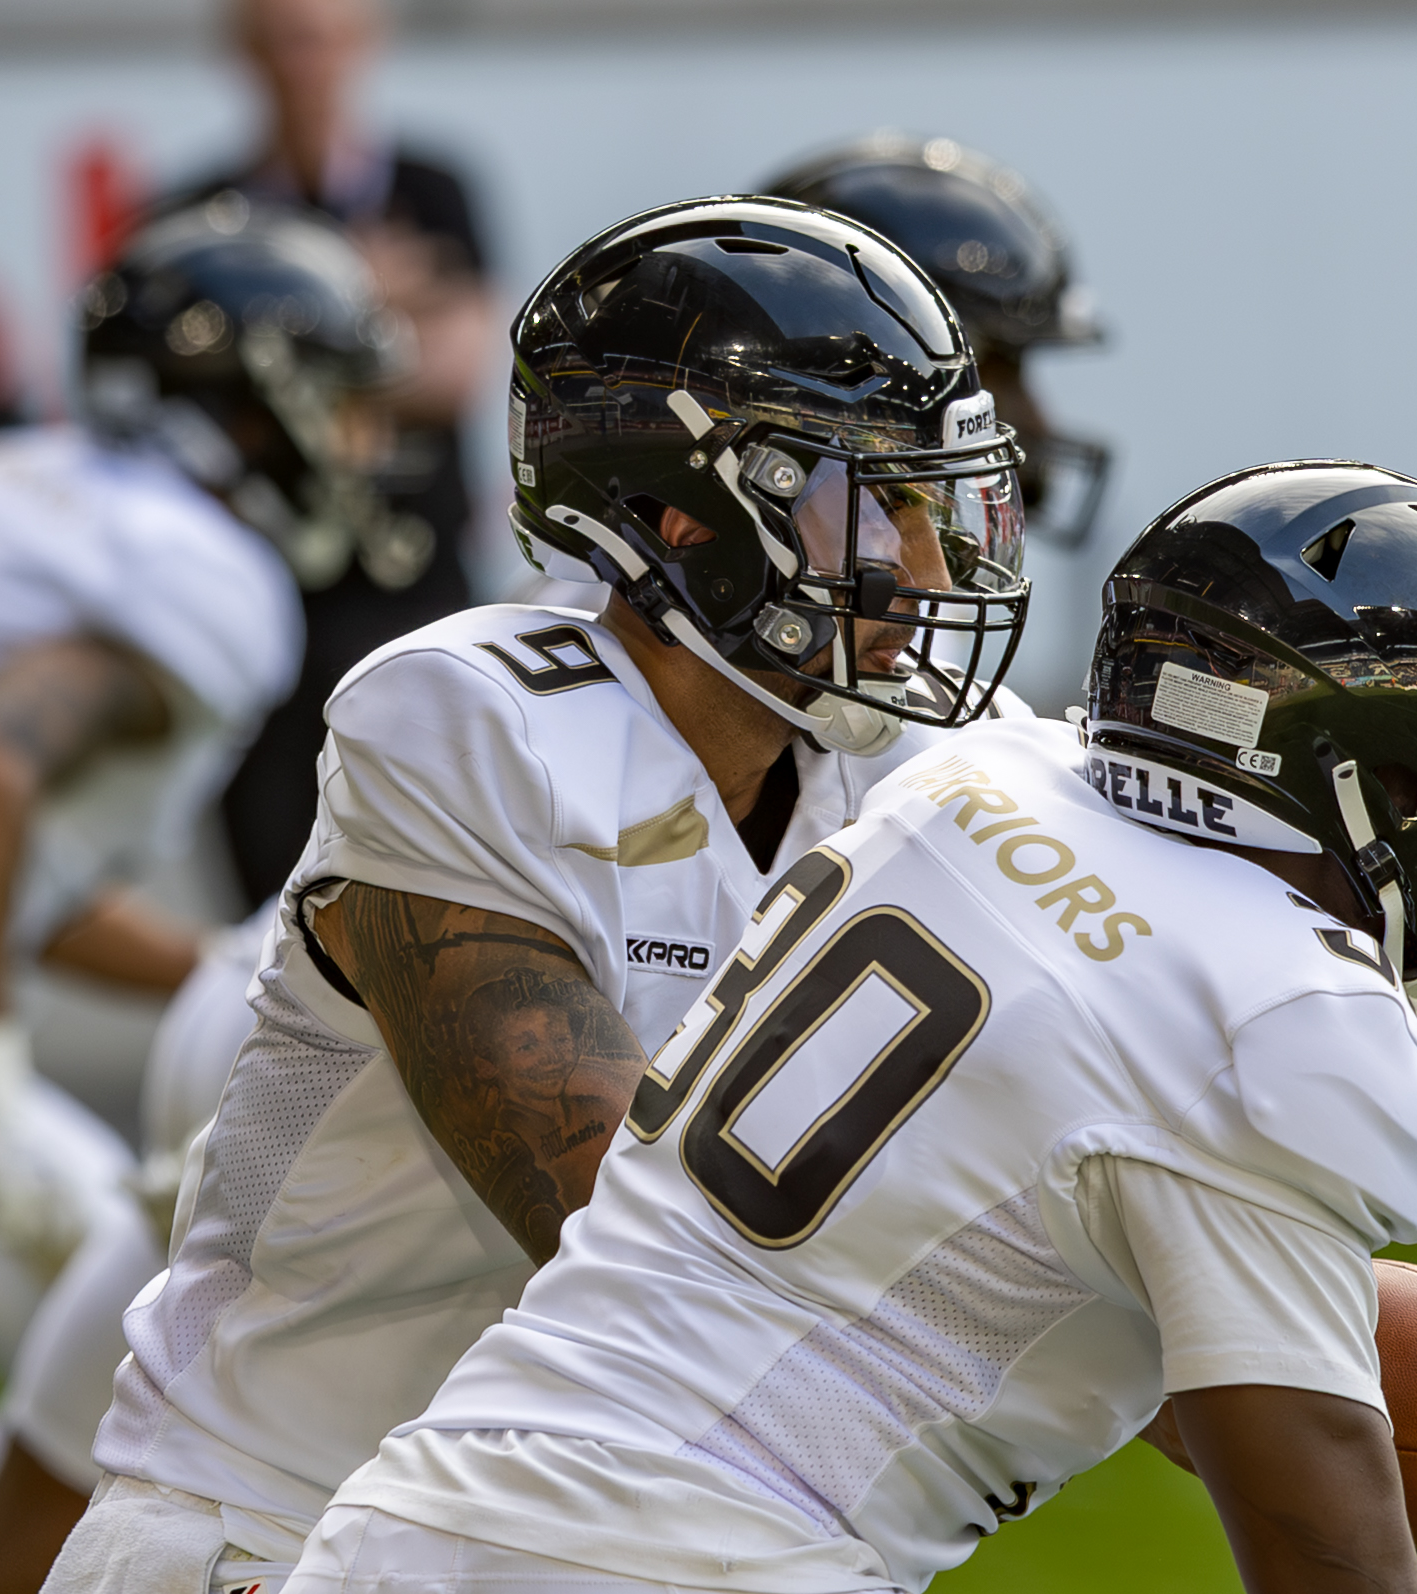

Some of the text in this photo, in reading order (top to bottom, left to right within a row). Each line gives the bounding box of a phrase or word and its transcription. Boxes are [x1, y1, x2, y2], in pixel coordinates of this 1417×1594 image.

[472, 624, 621, 696] 9
[1191, 673, 1232, 692] WARNING
[1085, 757, 1237, 837] RELLE
[625, 845, 991, 1251] 30
